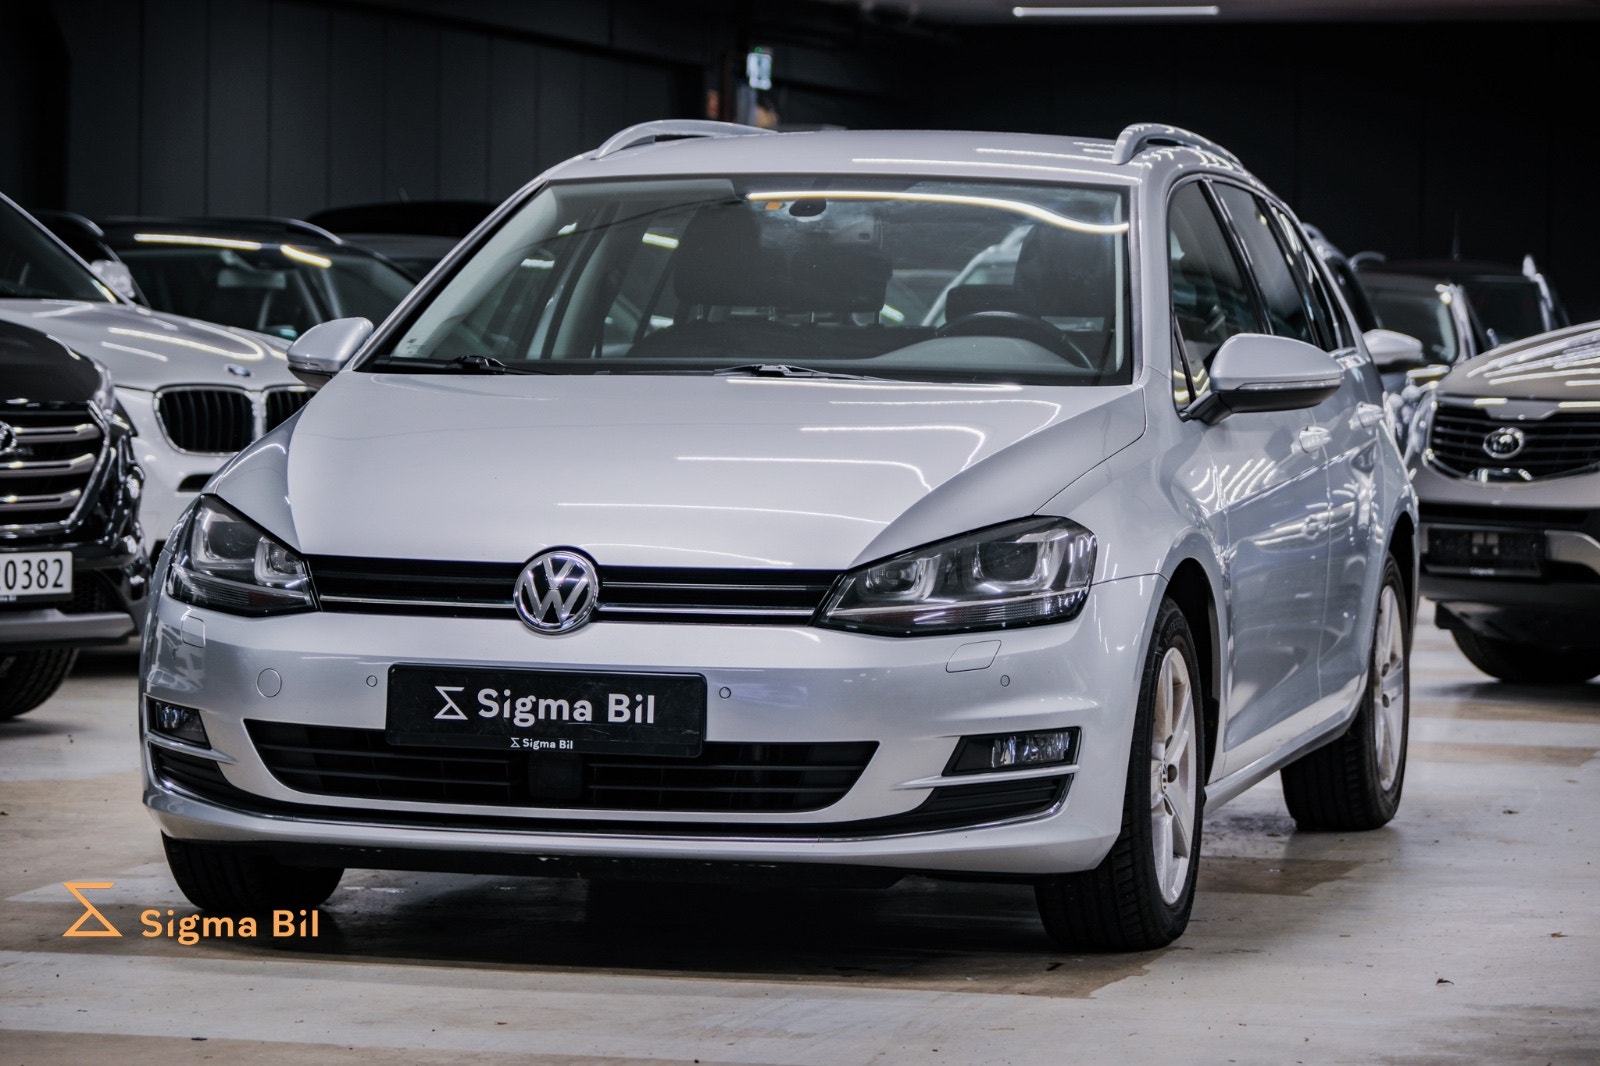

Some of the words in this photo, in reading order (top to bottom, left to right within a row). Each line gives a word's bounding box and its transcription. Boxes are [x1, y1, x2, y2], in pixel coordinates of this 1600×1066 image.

[4, 558, 64, 591] 0382
[517, 554, 593, 627] VW
[477, 688, 593, 728] Sigma
[607, 693, 655, 724] Bil
[522, 737, 556, 751] Sigma
[559, 739, 573, 750] Bil
